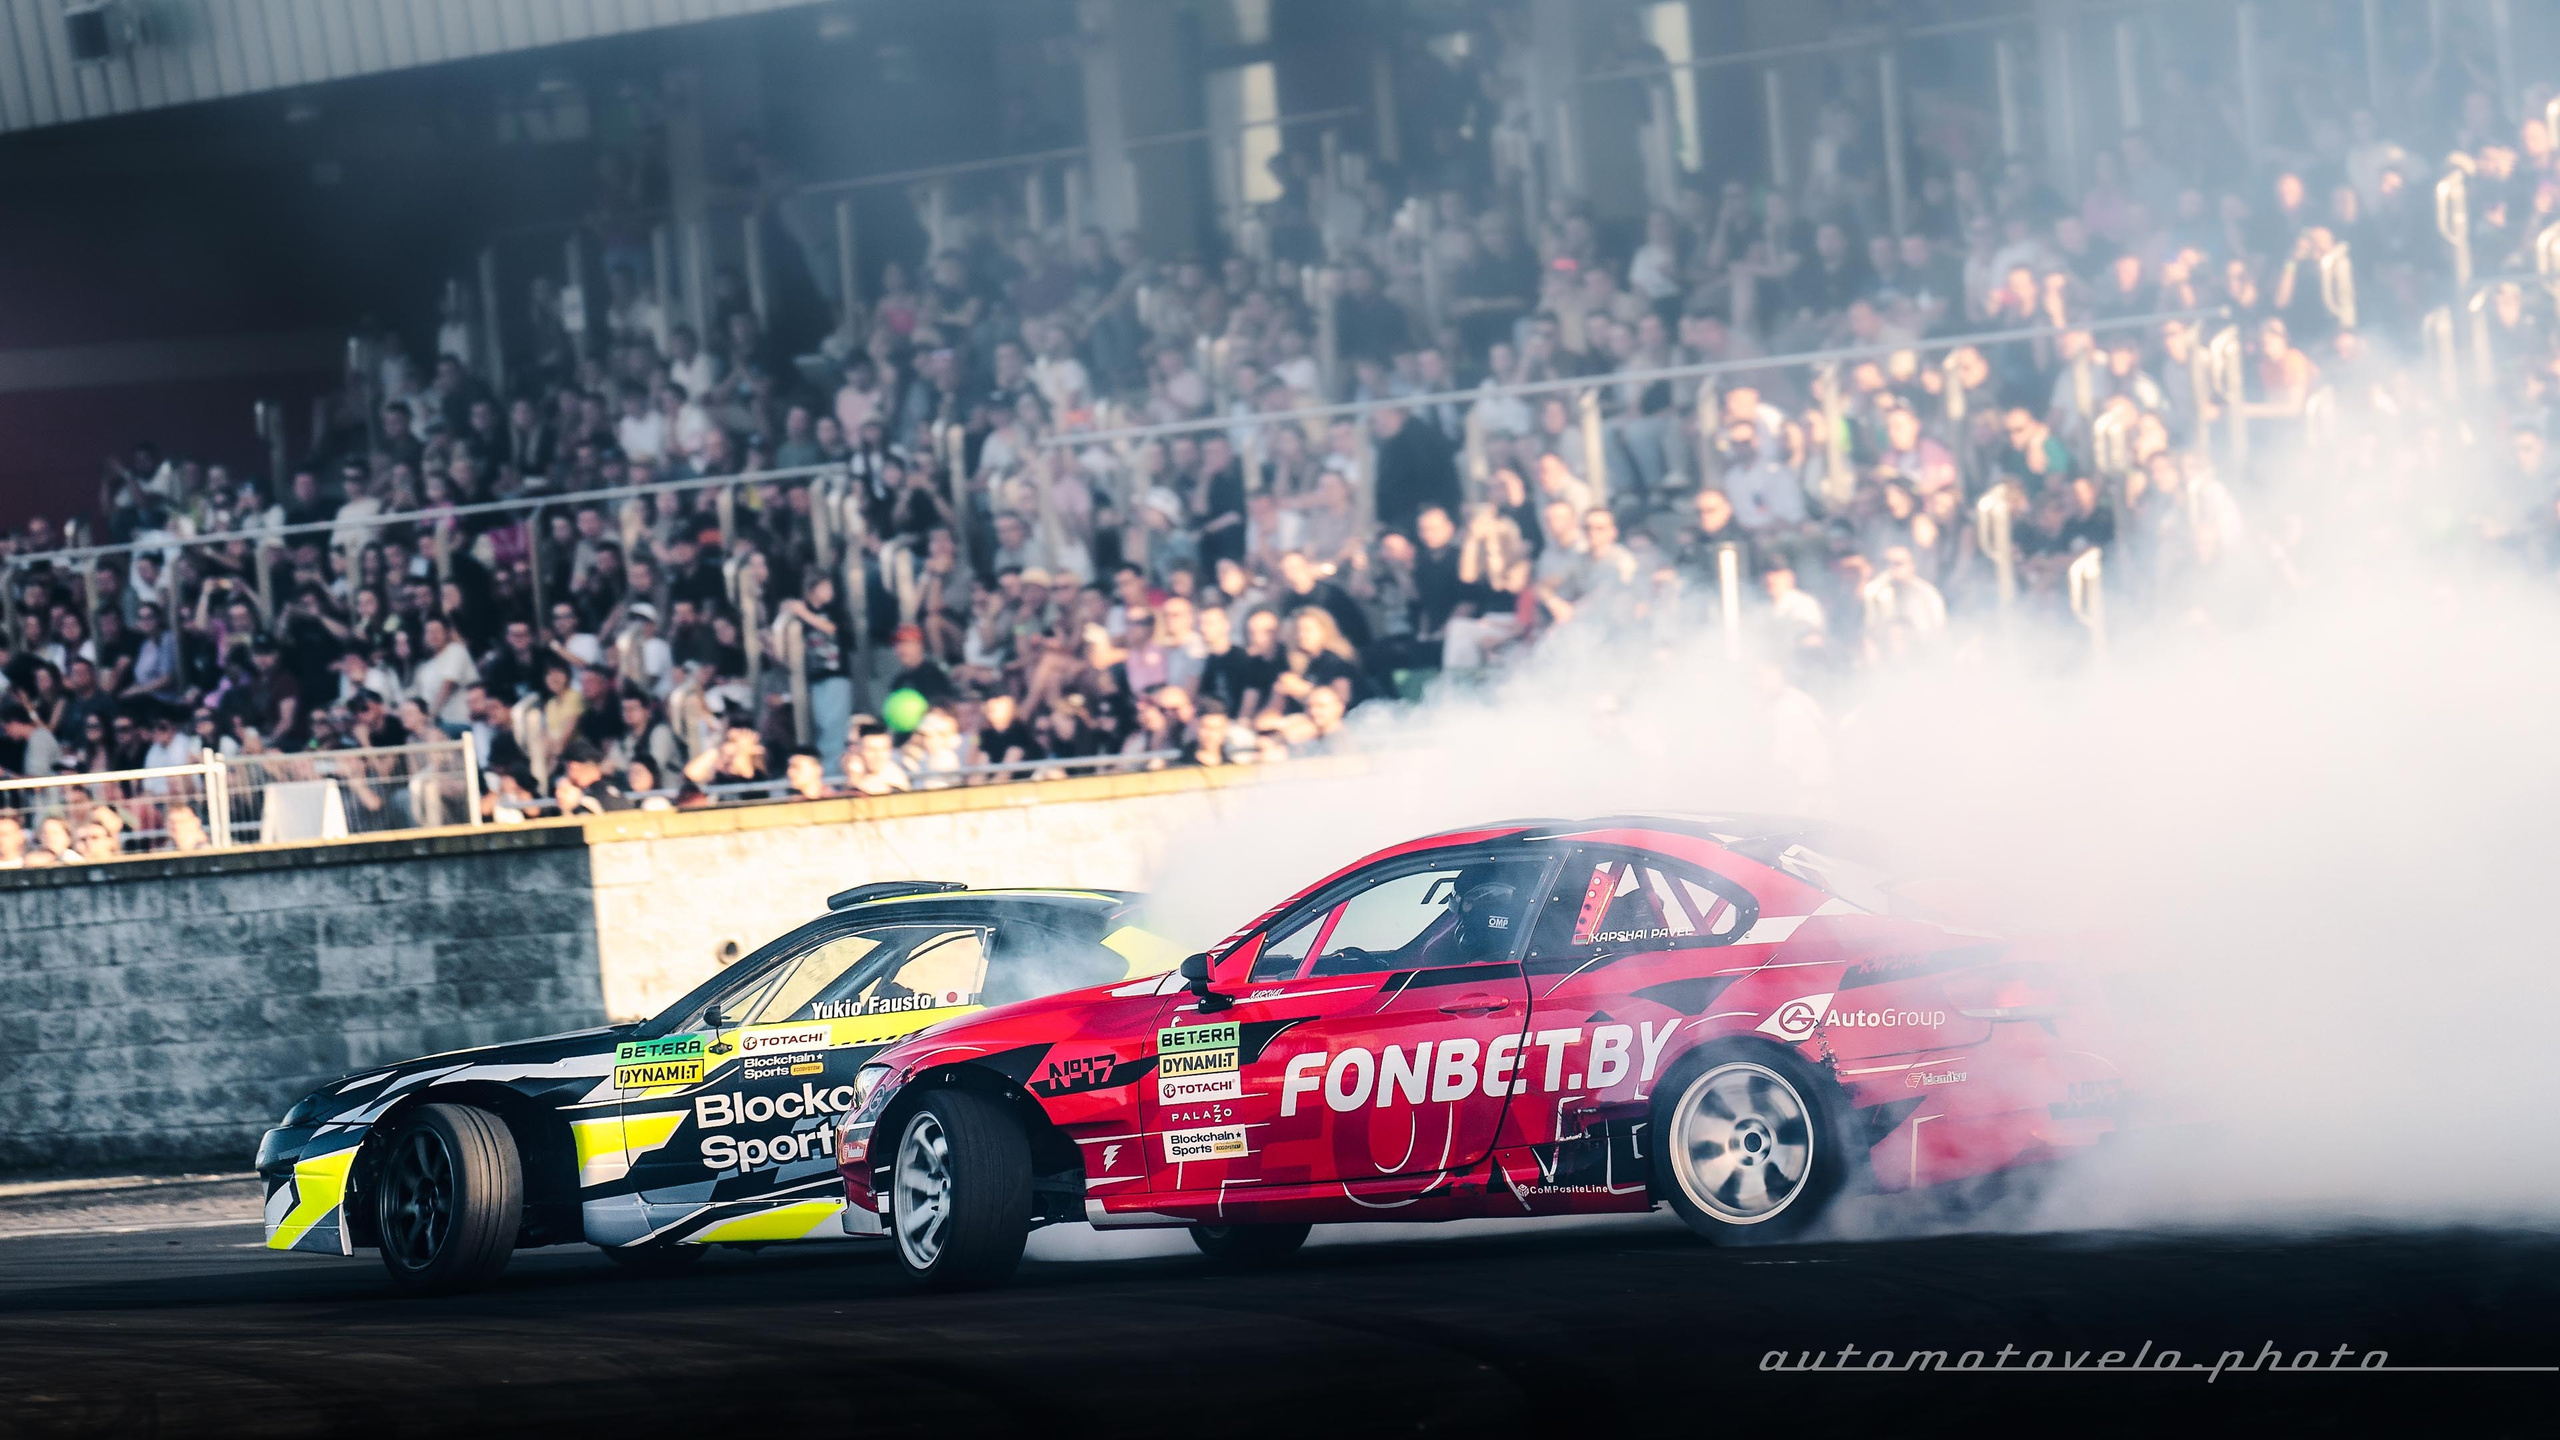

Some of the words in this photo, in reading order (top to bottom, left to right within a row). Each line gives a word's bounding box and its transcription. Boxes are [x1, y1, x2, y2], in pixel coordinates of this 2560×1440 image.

[1591, 929, 1647, 943] KAPSHAI
[1651, 926, 1694, 939] PAVEL
[811, 998, 862, 1020] Yukio
[868, 993, 932, 1015] Fausto
[1825, 1008, 1946, 1030] AutoGroup
[760, 1033, 823, 1047] TOTACHI
[743, 1053, 815, 1068] Blockchain
[1280, 1018, 1683, 1117] FONBET.BY
[744, 1066, 789, 1080] Sports
[1177, 1080, 1232, 1095] TOTACHI
[1170, 1131, 1234, 1145] Blockchain
[1172, 1144, 1212, 1157] Sports
